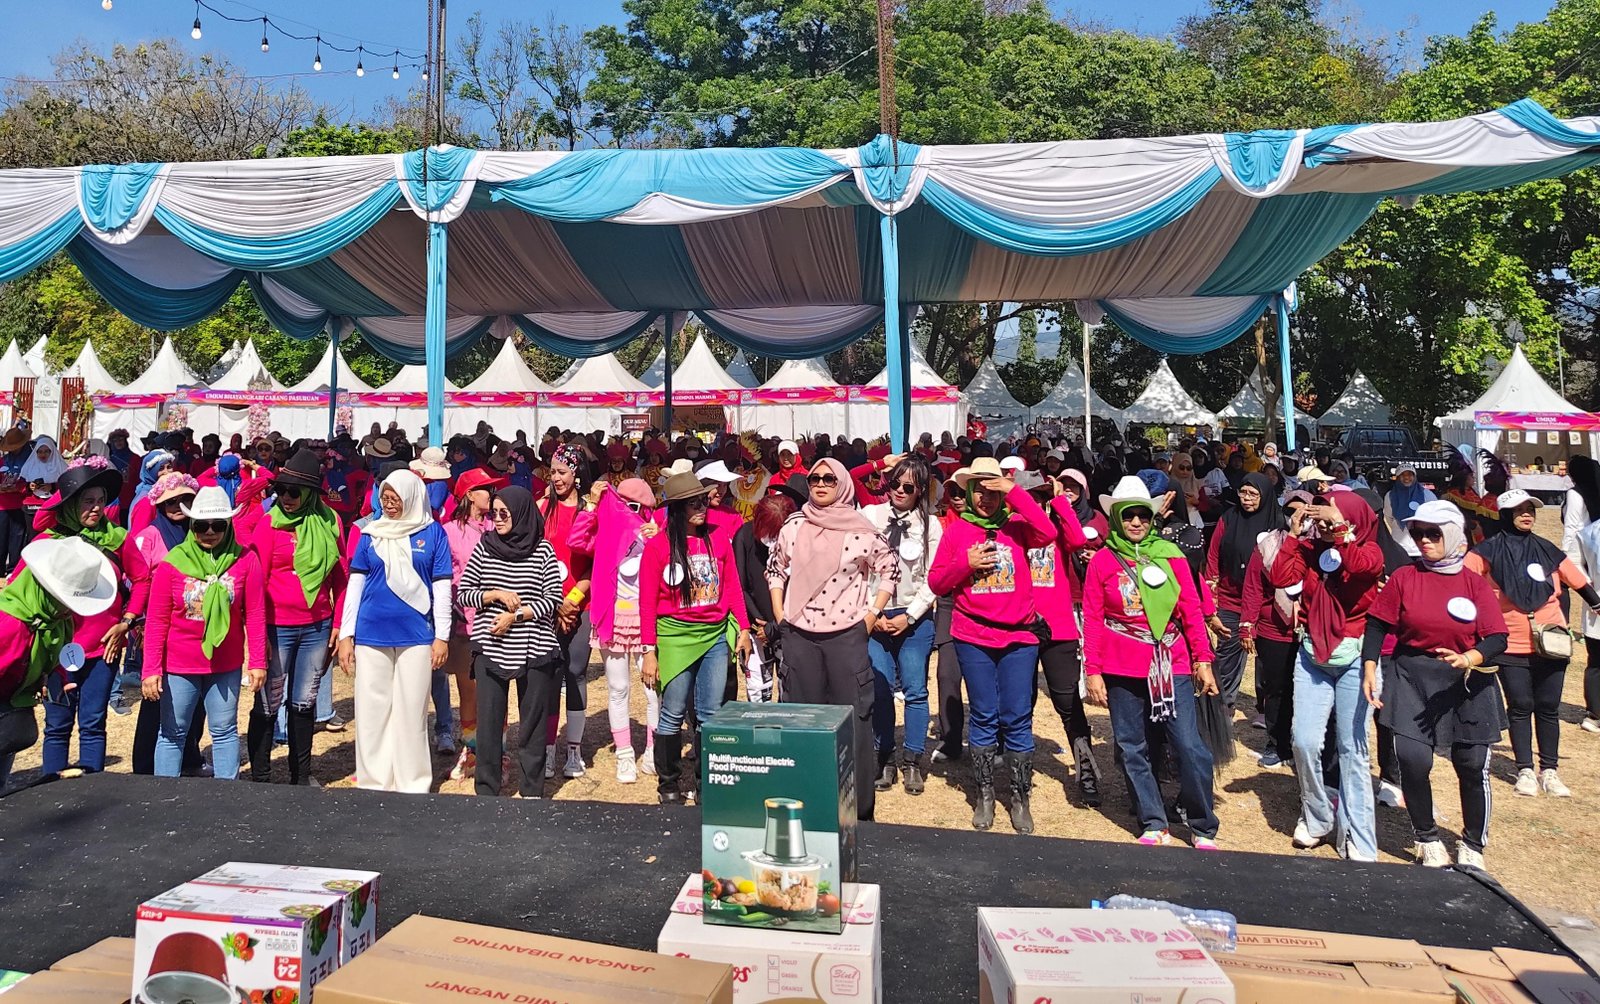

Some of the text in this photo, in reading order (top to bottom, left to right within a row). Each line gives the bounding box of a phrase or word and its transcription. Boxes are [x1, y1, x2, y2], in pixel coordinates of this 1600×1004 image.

[708, 753, 795, 767] Multifunctional Electric
[708, 762, 770, 774] Food Processor
[711, 900, 723, 910] 2L
[1263, 937, 1319, 946] HANDLE
[452, 935, 655, 973] JANGAN DIBANTING
[277, 963, 298, 979] 24
[425, 981, 510, 1000] JANGAN
